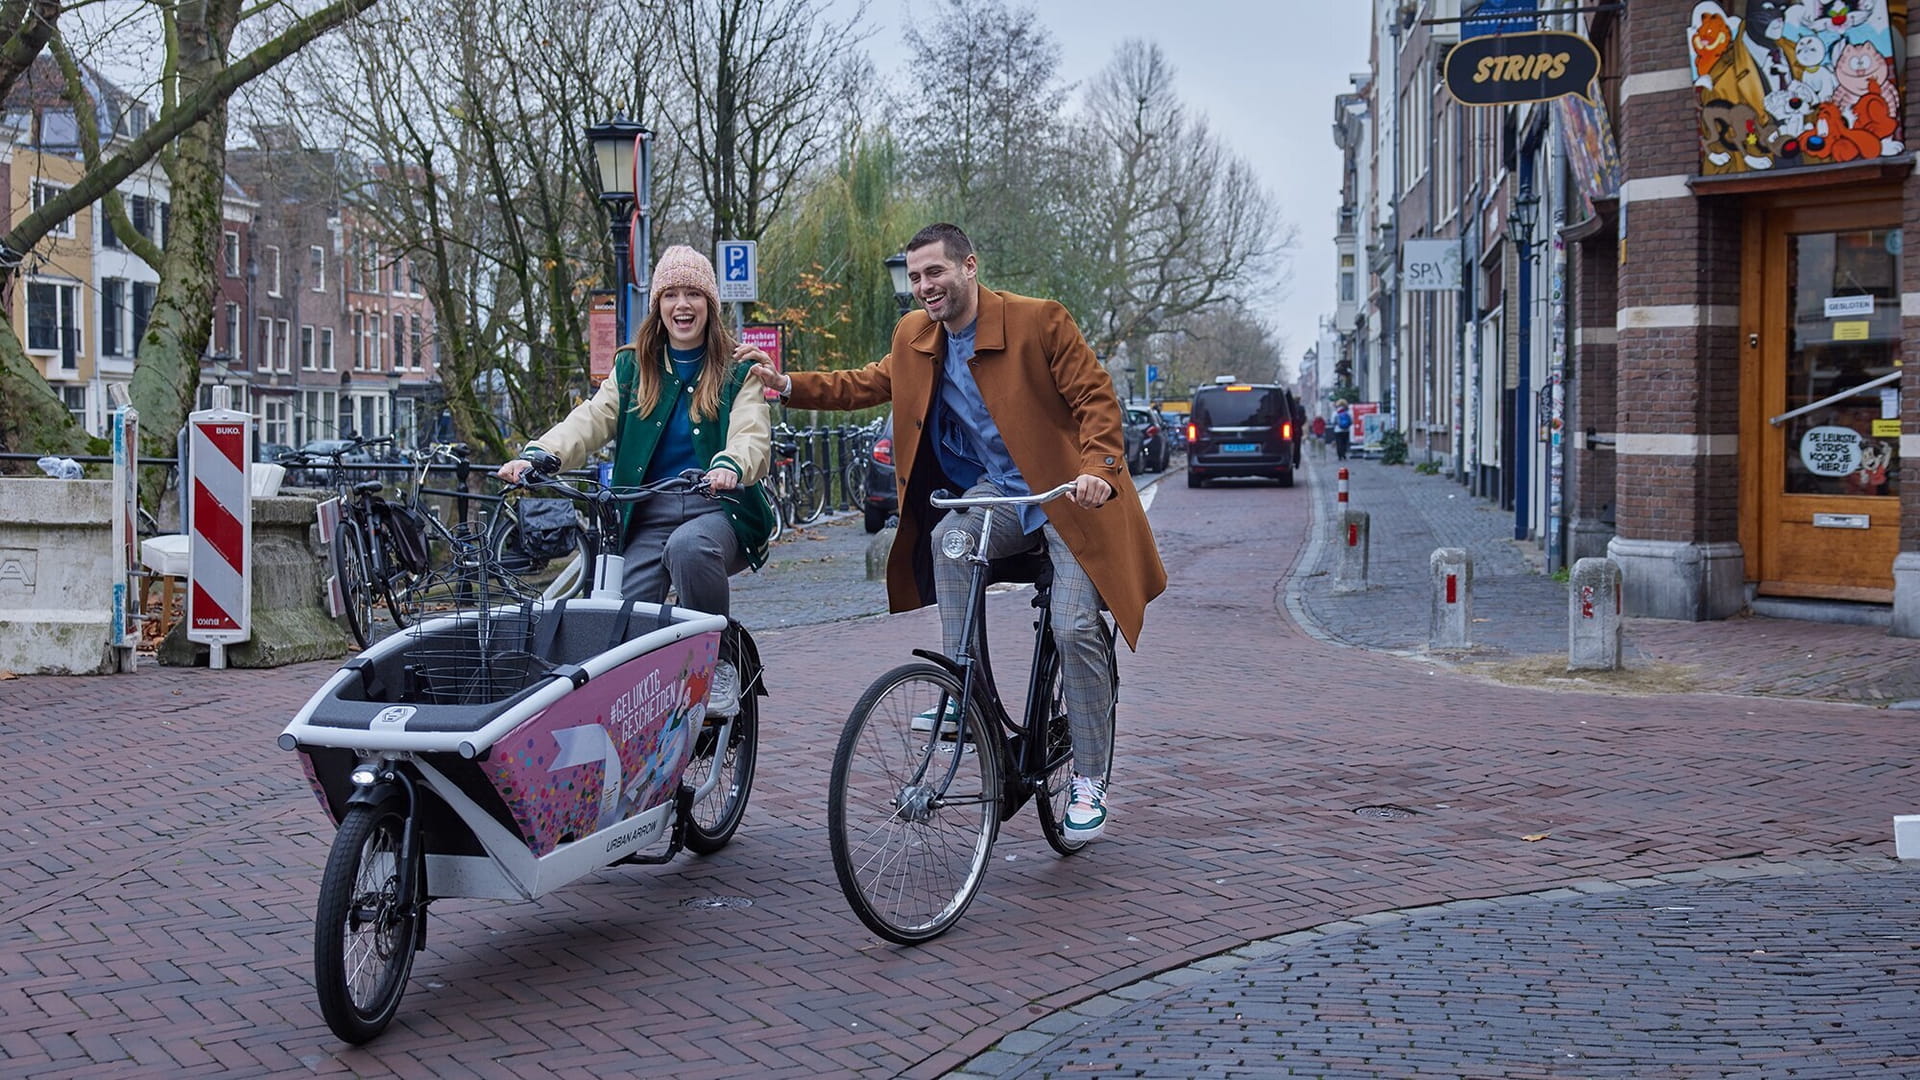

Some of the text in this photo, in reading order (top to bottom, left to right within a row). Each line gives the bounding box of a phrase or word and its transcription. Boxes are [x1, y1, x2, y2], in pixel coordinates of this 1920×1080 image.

[1472, 52, 1571, 83] STRIPS
[730, 247, 744, 266] P
[1809, 432, 1857, 443] DE LEUKSTE
[1815, 443, 1850, 453] STRIPS
[1809, 452, 1852, 463] KOOP JE
[610, 668, 660, 726] #GELUKKIG
[622, 680, 676, 743] GESCHEIDEN
[606, 820, 658, 853] URBAN ARROW
